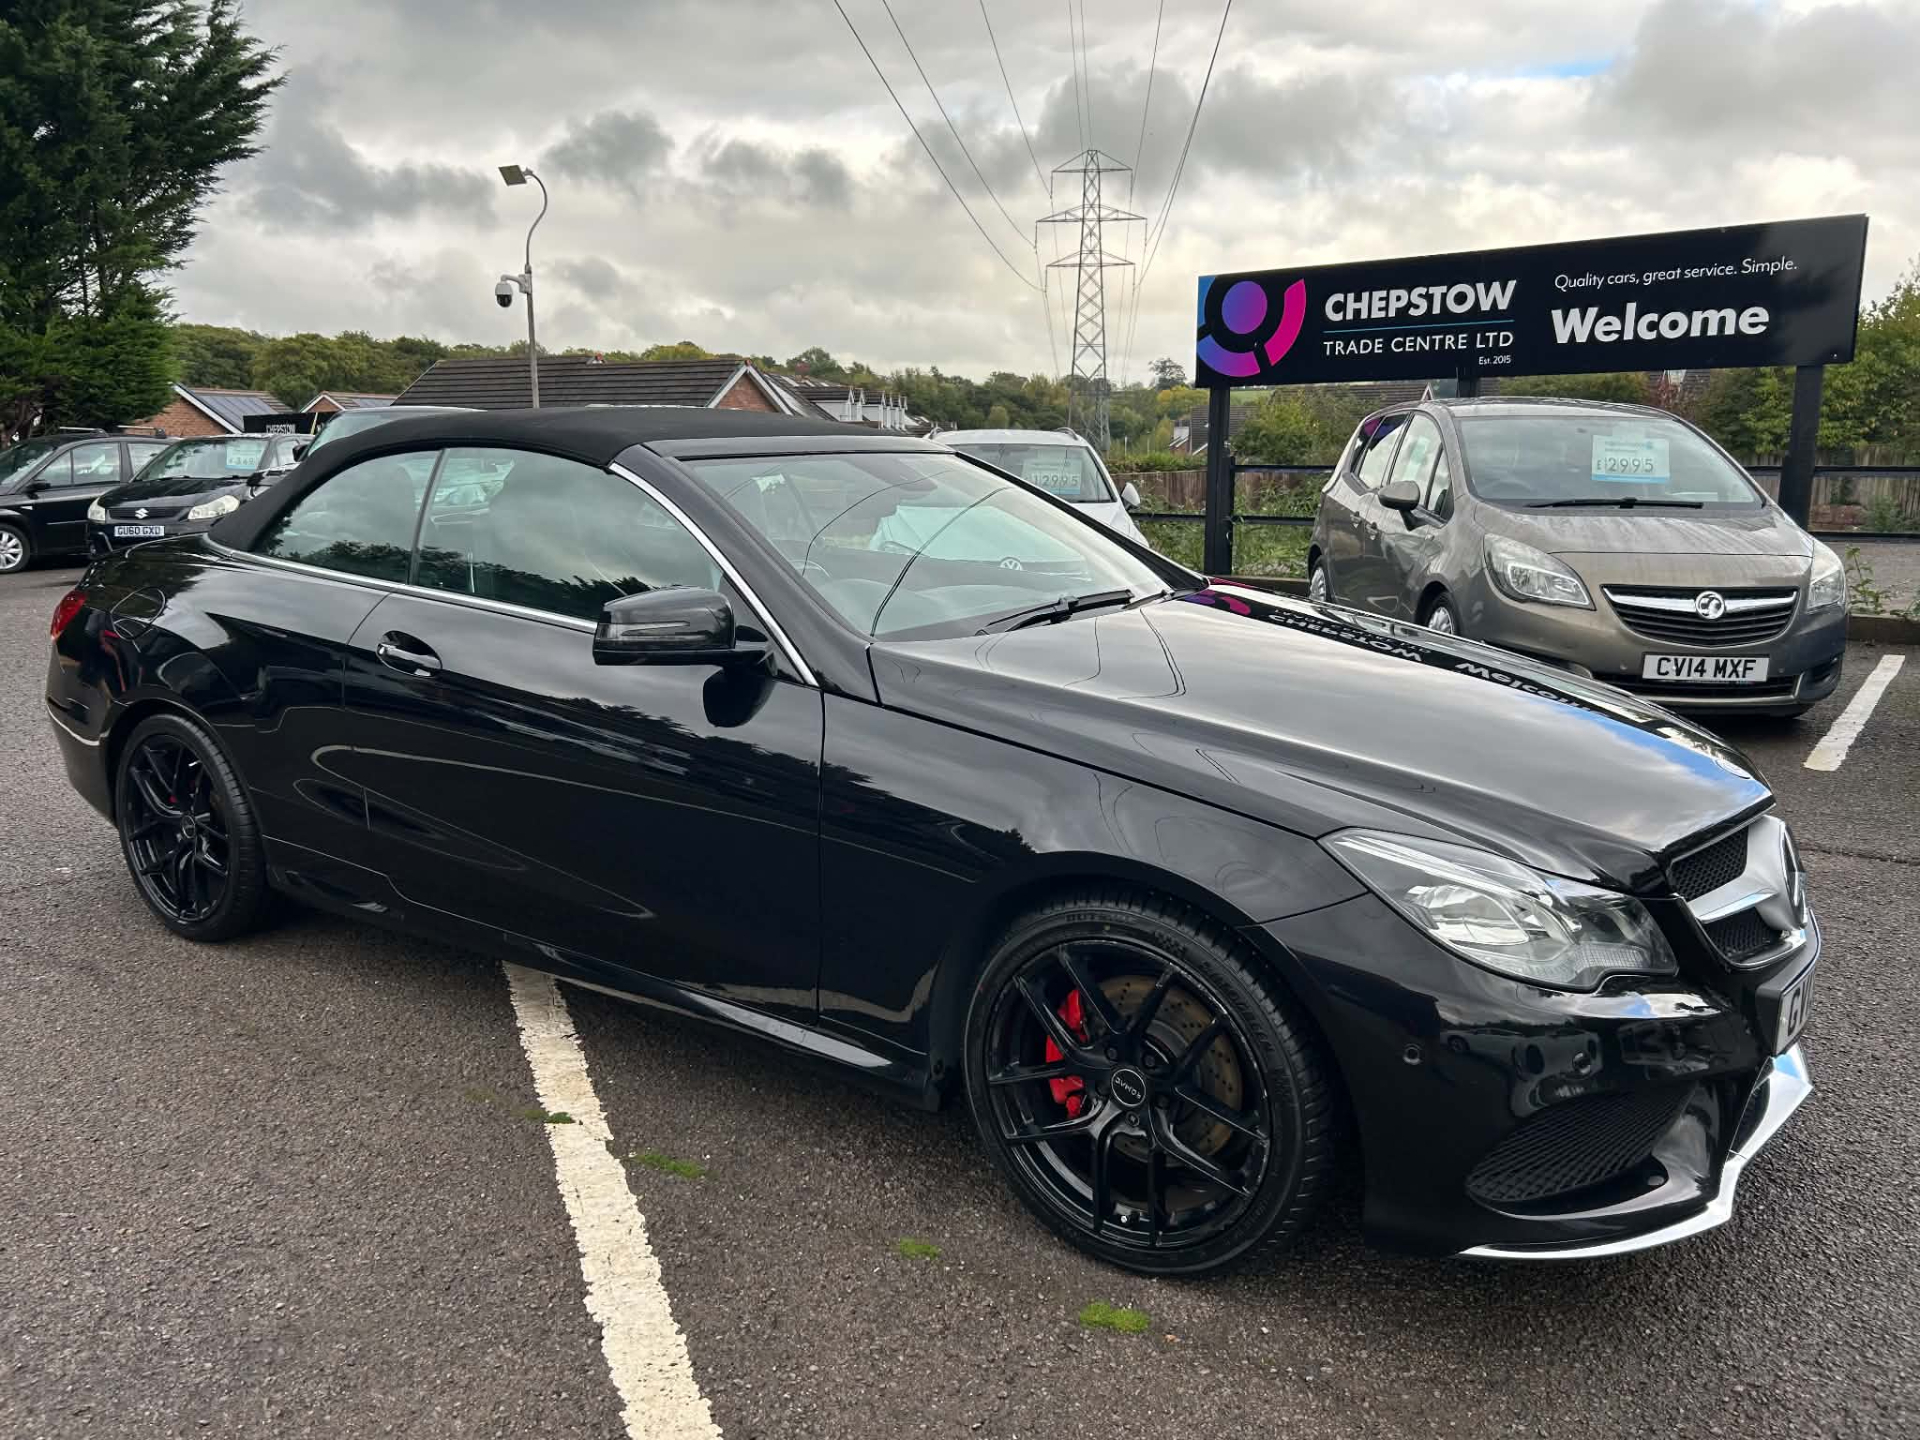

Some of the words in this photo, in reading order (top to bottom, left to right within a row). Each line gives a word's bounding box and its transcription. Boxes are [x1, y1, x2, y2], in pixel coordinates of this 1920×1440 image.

[1554, 273, 1604, 292] Quality
[1607, 273, 1639, 285] cars,
[1642, 267, 1681, 286] great
[1683, 263, 1738, 278] service.
[1740, 256, 1798, 275] Simple.
[1325, 279, 1517, 322] CHEPSTOW
[1551, 302, 1770, 344] Welcome
[1323, 338, 1384, 356] TRADE
[1390, 333, 1468, 352] CENTRE
[1476, 331, 1514, 349] LTD
[1478, 356, 1492, 365] Est.
[1492, 354, 1512, 365] 2015
[117, 526, 141, 536] GU60
[142, 526, 161, 535] GXD
[1656, 656, 1707, 678] CV14
[1713, 658, 1757, 679] MXF
